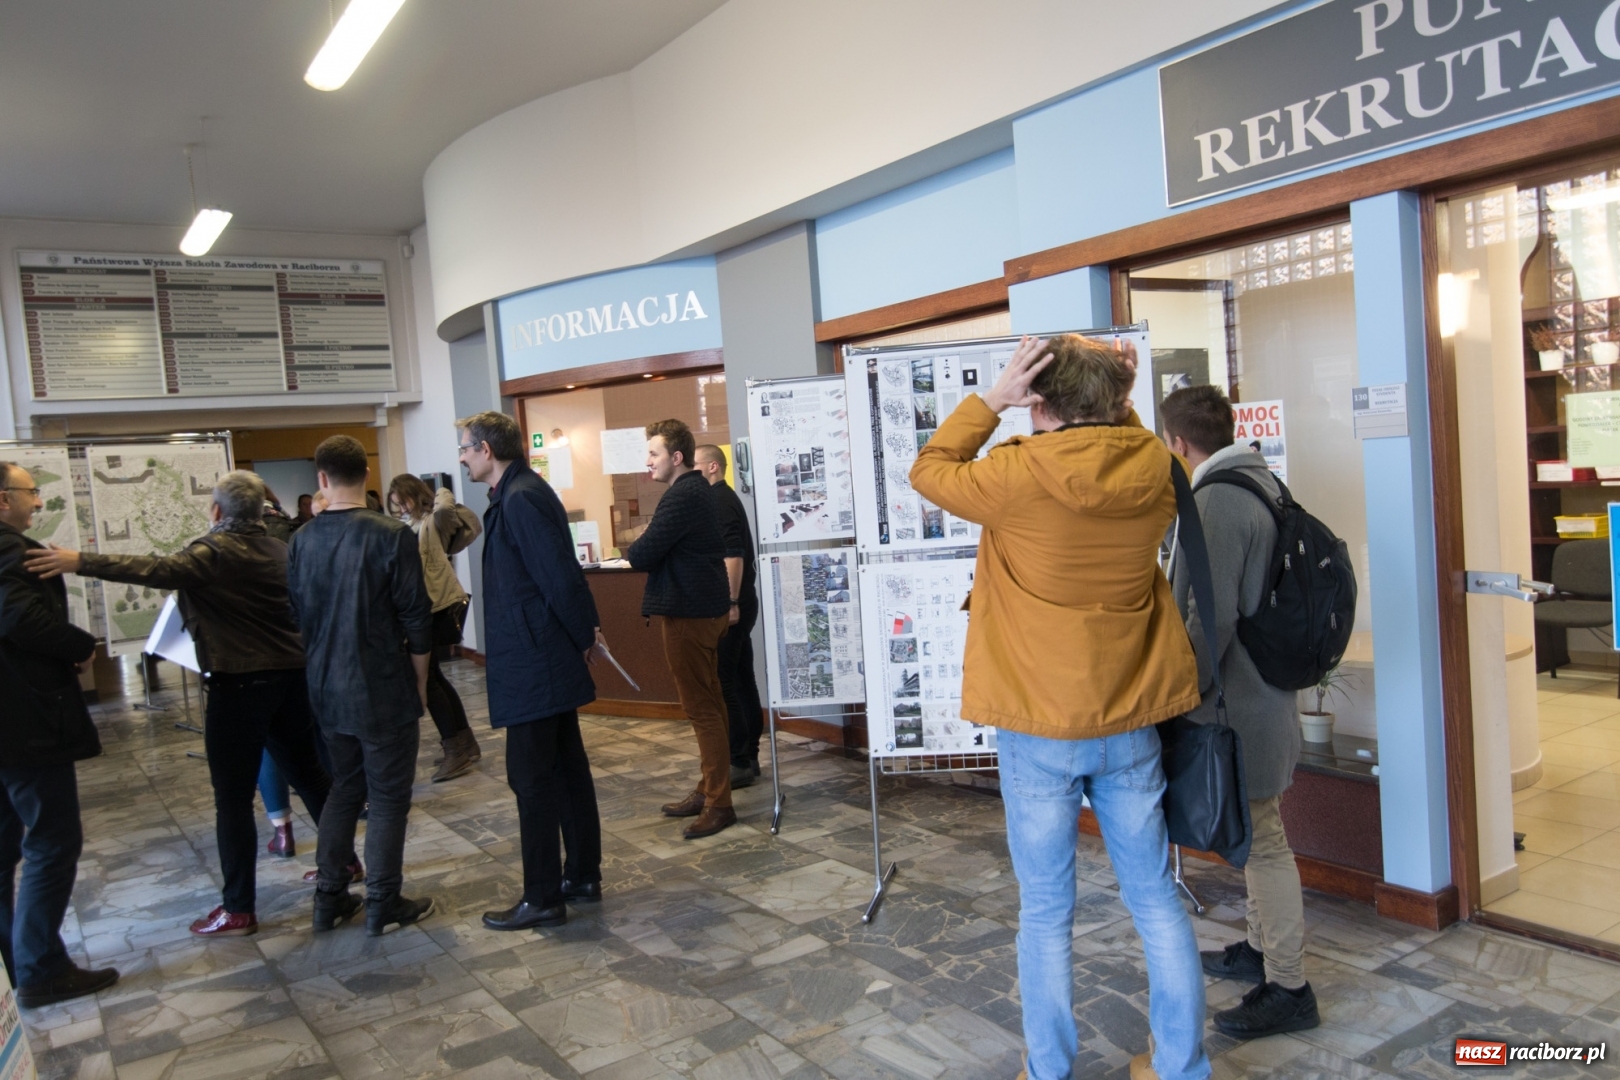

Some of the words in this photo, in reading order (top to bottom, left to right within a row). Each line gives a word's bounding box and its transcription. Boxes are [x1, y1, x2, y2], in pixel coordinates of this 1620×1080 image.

[73, 256, 140, 266] Państwowa
[142, 258, 183, 268] Wyższa
[185, 260, 221, 268] Szkoła
[224, 261, 278, 270] Zawodowa
[291, 263, 341, 271] Raciborzu
[508, 290, 708, 350] INFORMACJA
[1354, 394, 1368, 402] 130
[1234, 424, 1248, 438] A
[1252, 422, 1280, 438] OLI
